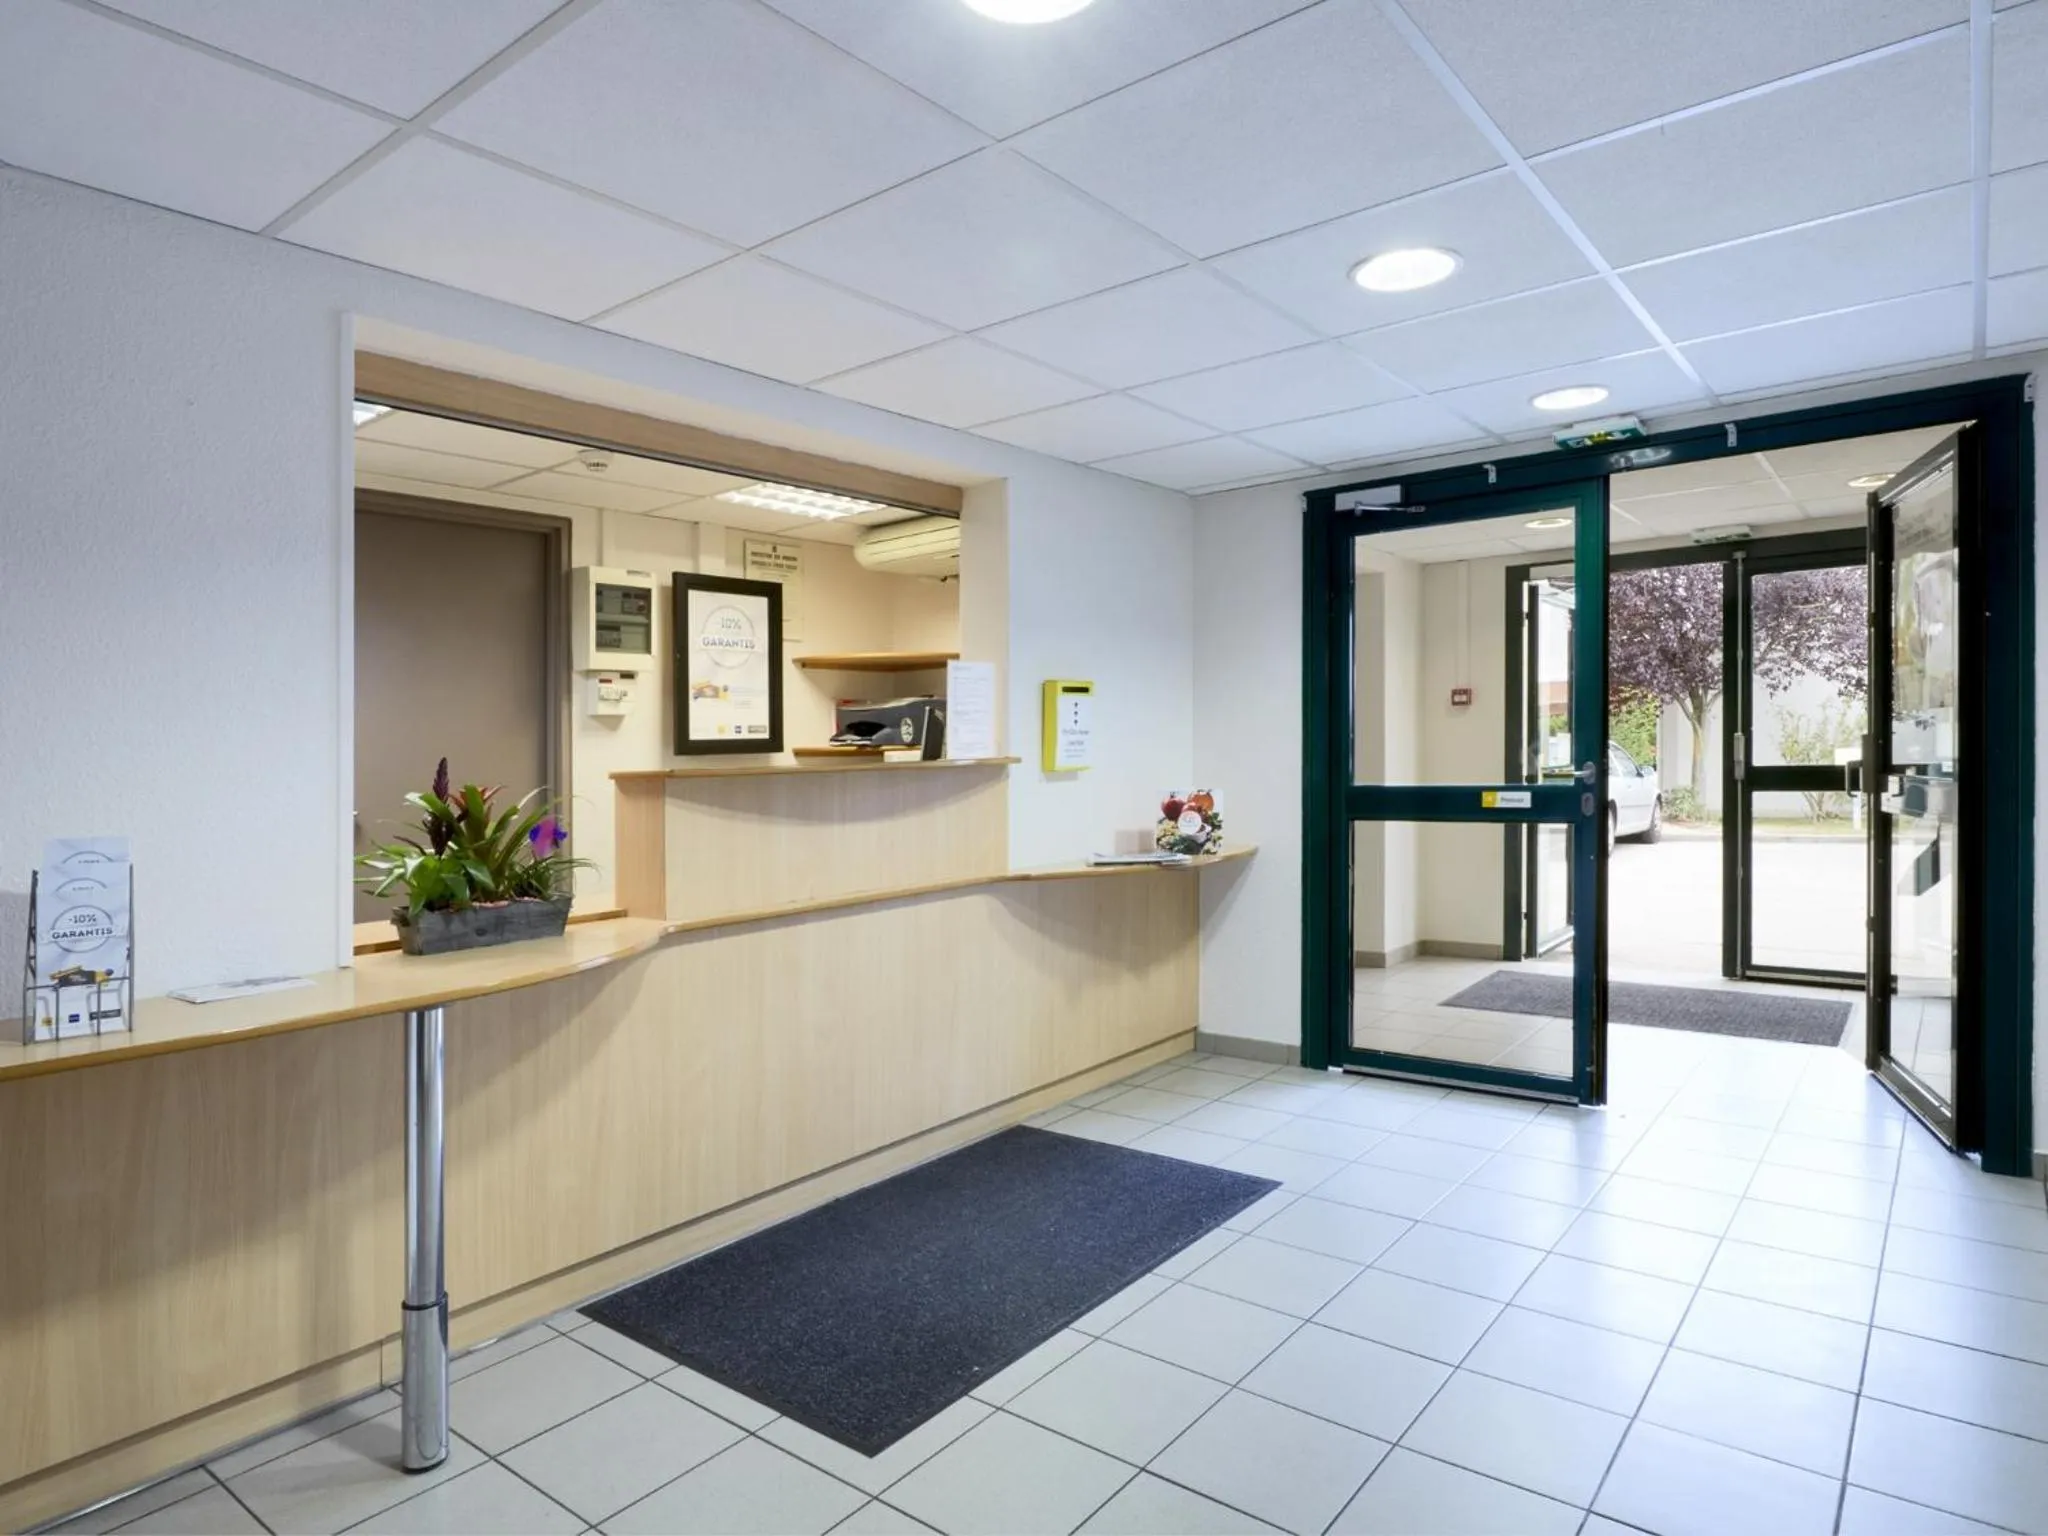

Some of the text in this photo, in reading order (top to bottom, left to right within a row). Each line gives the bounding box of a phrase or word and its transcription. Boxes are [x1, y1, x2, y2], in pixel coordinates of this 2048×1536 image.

[702, 637, 756, 650] GARANTIS
[68, 913, 97, 924] -10%
[52, 927, 113, 940] GARANTIS
